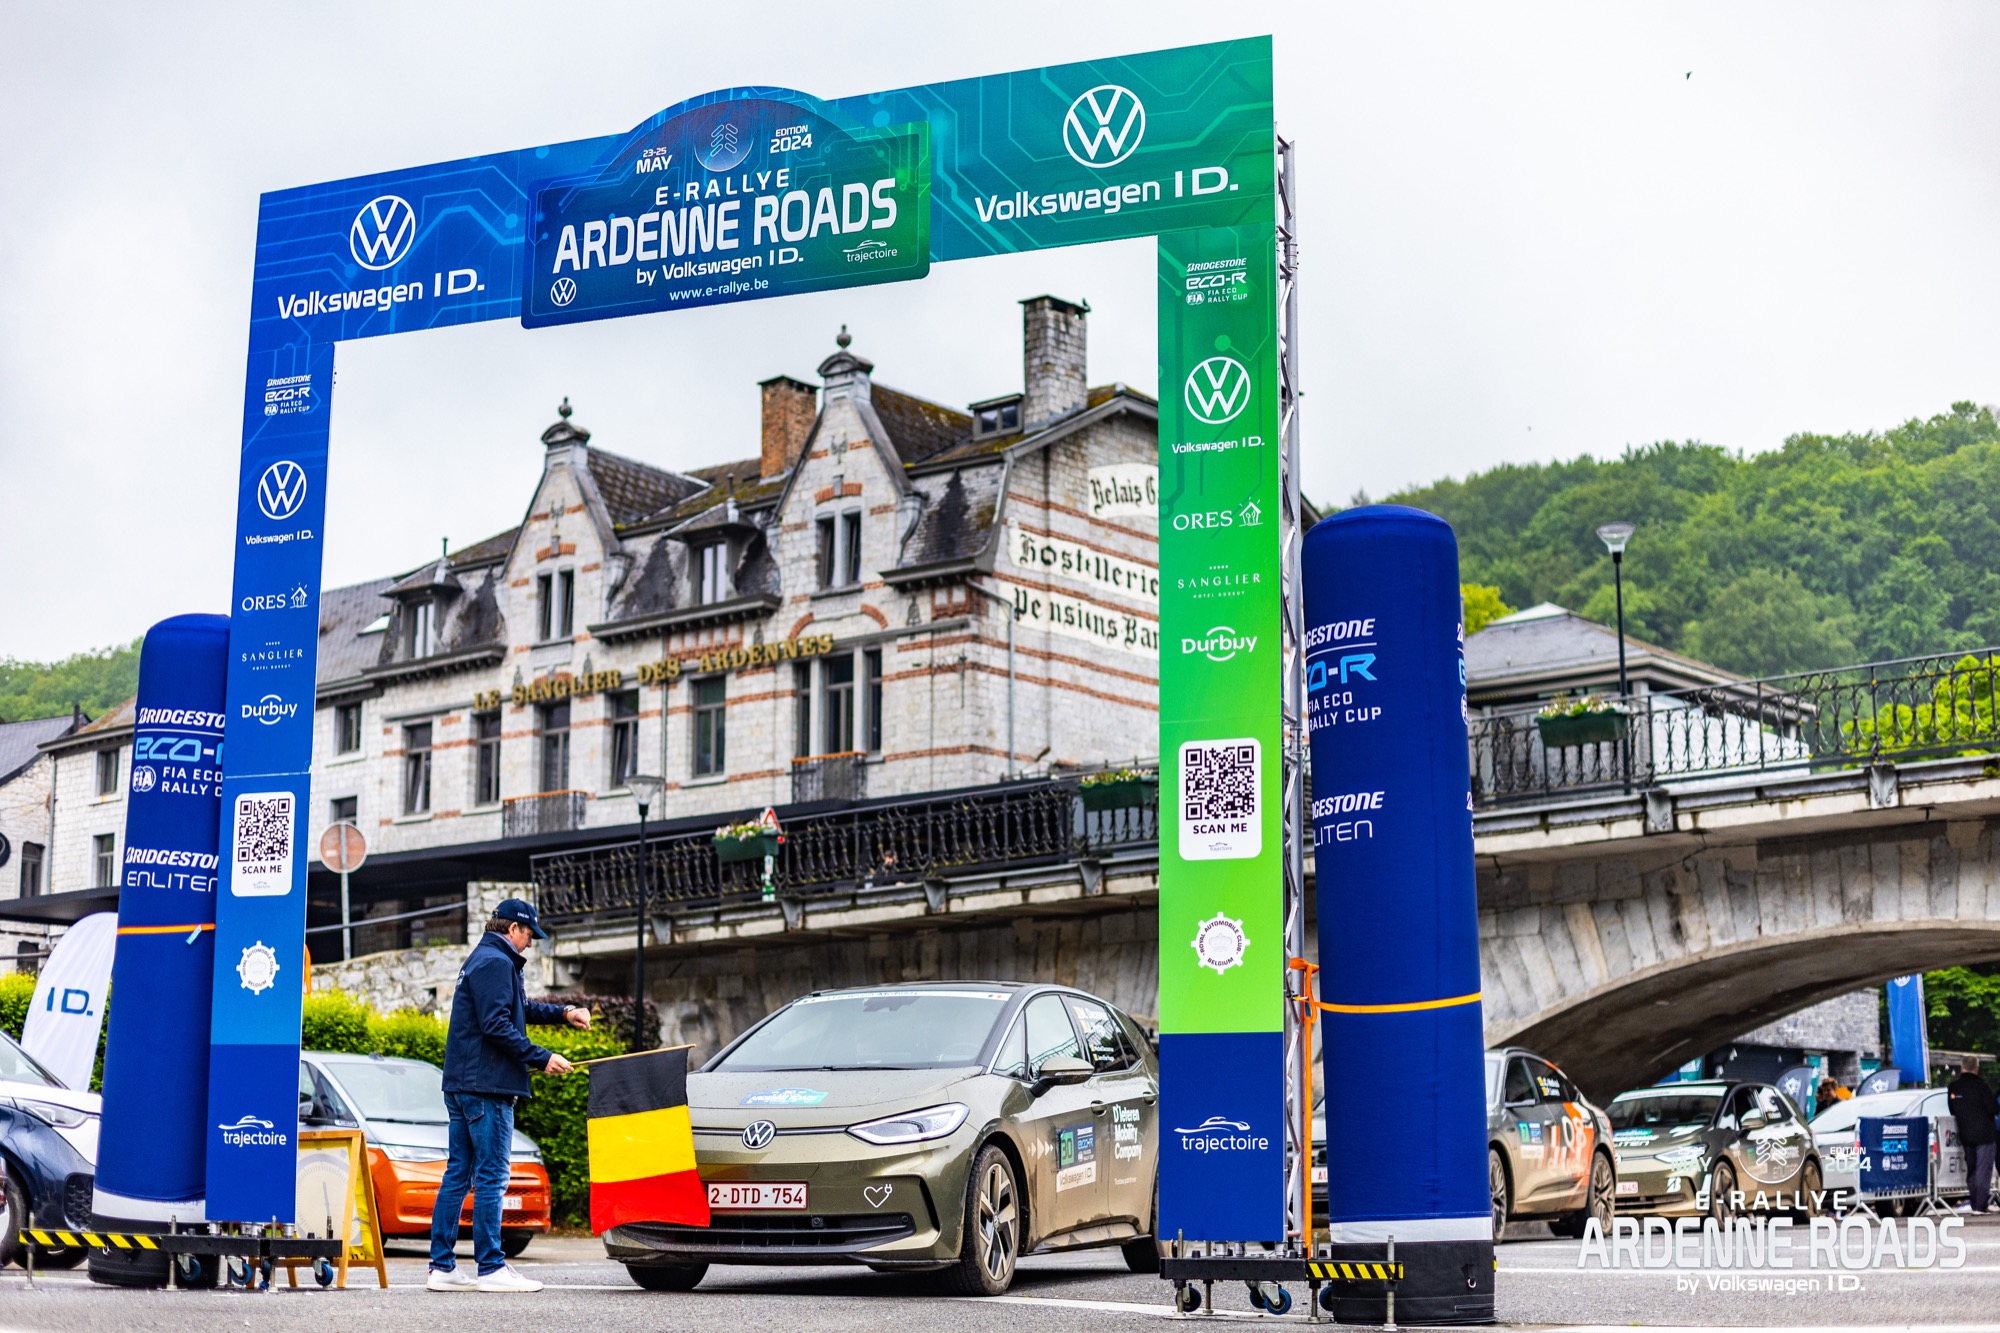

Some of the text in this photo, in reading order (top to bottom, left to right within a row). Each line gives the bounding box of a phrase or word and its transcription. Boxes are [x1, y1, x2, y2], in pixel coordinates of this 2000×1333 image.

[775, 125, 808, 137] EDITION
[643, 146, 667, 158] 23-25
[770, 133, 813, 154] 2024
[636, 155, 673, 174] MAY
[656, 168, 790, 206] E-RALLYE
[974, 166, 1239, 223] Volkswagen ID.
[552, 178, 898, 274] ARDENNE ROADS
[847, 248, 898, 263] trajectoire
[636, 247, 804, 286] by Volkswagen ID.
[1186, 258, 1247, 272] BRIDGESTONE
[277, 268, 485, 320] Volkswagen ID.
[669, 279, 769, 301] www.e-rallye.be
[1208, 295, 1230, 303] RALLY
[266, 374, 312, 387] BRIDGESTONE
[1171, 436, 1265, 454] Volkswagen ID.
[1173, 510, 1233, 531] ORES
[245, 530, 314, 545] Volkswagen ID.
[1177, 573, 1261, 589] SANGLIER
[241, 594, 286, 612] ORES
[1305, 618, 1376, 650] GESTONE
[1181, 634, 1258, 654] Durbuy
[241, 648, 303, 663] SANGLIER
[473, 633, 834, 710] LE SANGLIER DES ARDENNES
[1323, 691, 1353, 709] ECO
[138, 707, 226, 729] BRIDGESTO
[241, 701, 298, 718] Durbuy
[1309, 706, 1382, 732] RALLY CUP
[163, 766, 223, 783] FIA ECO
[161, 781, 208, 796] RALLY
[1192, 822, 1248, 835] SCAN ME
[242, 864, 282, 875] SCAN ME
[1204, 920, 1239, 934] AUTOMOBILE
[1207, 956, 1234, 967] BELGIUM
[46, 987, 94, 1017] ID.
[1112, 1104, 1140, 1123] D'Ieteren
[223, 1130, 287, 1148] trajectoire
[1114, 1122, 1138, 1143] Mobility
[1114, 1142, 1142, 1162] Company
[1181, 1134, 1269, 1154] trajectoire
[710, 1188, 803, 1205] 2-DTD-754
